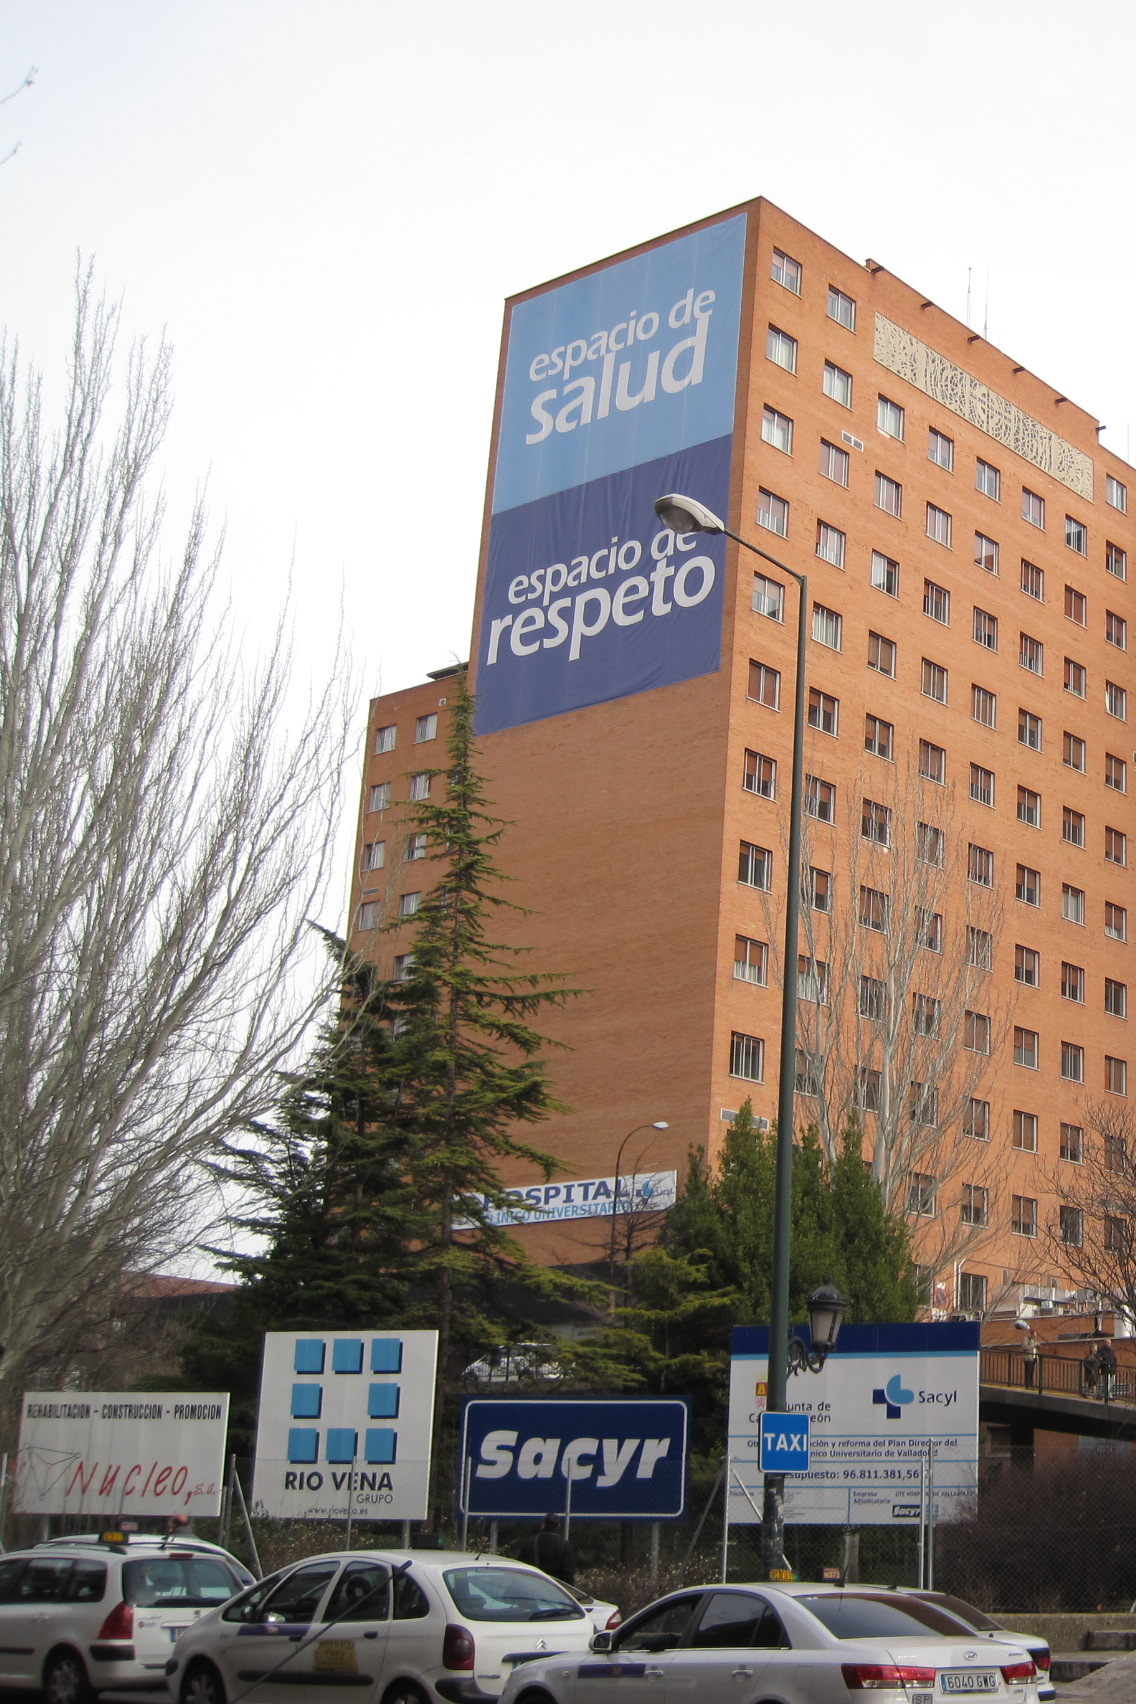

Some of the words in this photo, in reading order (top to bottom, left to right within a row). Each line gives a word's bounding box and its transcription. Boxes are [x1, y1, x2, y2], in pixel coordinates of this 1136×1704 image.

[529, 310, 659, 382] espacio
[669, 287, 716, 329] de
[525, 312, 709, 445] salud
[507, 536, 642, 605] espacio
[486, 555, 716, 665] respeto
[918, 1390, 957, 1406] Sacyl
[27, 1404, 91, 1419] REHABILITACION
[102, 1404, 163, 1419] CONSTRUCCION
[173, 1404, 222, 1419] PROMOCION
[786, 1401, 812, 1412] unta
[817, 1401, 831, 1412] de
[810, 1413, 831, 1423] eón
[763, 1433, 807, 1452] TAXI
[831, 1441, 836, 1449] y
[838, 1439, 871, 1447] reforma
[873, 1439, 886, 1447] del
[888, 1439, 906, 1447] Plan
[908, 1439, 942, 1447] Direcor
[944, 1438, 958, 1447] del
[475, 1429, 671, 1488] Sacyr
[829, 1449, 882, 1458] Universitario
[884, 1449, 895, 1457] de
[285, 1471, 324, 1491] RIO
[331, 1471, 394, 1492] VENA
[842, 1469, 920, 1481] 96.811.381,56
[356, 1493, 394, 1504] GRUPO
[893, 1506, 921, 1517] Sacyr
[947, 1675, 974, 1689] 6040
[977, 1675, 996, 1688] GWG
